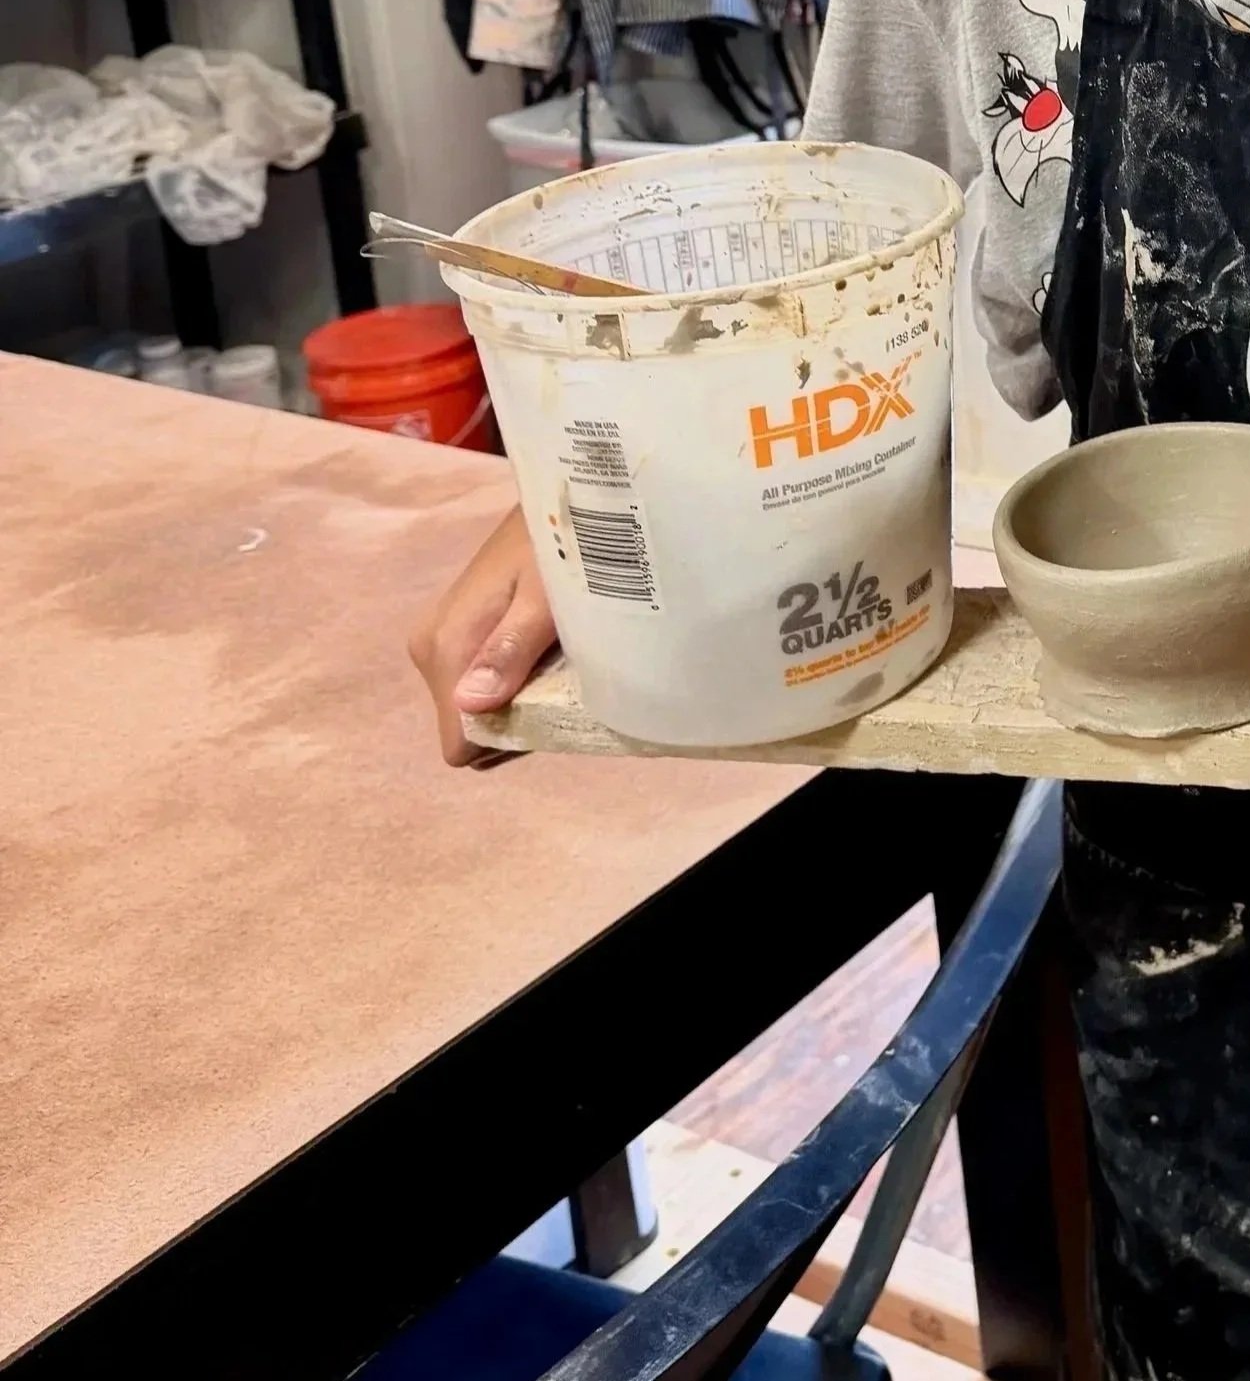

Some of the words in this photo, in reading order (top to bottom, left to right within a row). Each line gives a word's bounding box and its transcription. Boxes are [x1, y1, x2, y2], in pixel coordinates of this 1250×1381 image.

[890, 331, 909, 349] 138
[749, 356, 915, 468] HDX
[762, 486, 780, 501] All
[782, 473, 833, 496] Purpose
[835, 460, 872, 481] Mixing
[874, 436, 917, 465] Container
[781, 598, 893, 655] QUARTS
